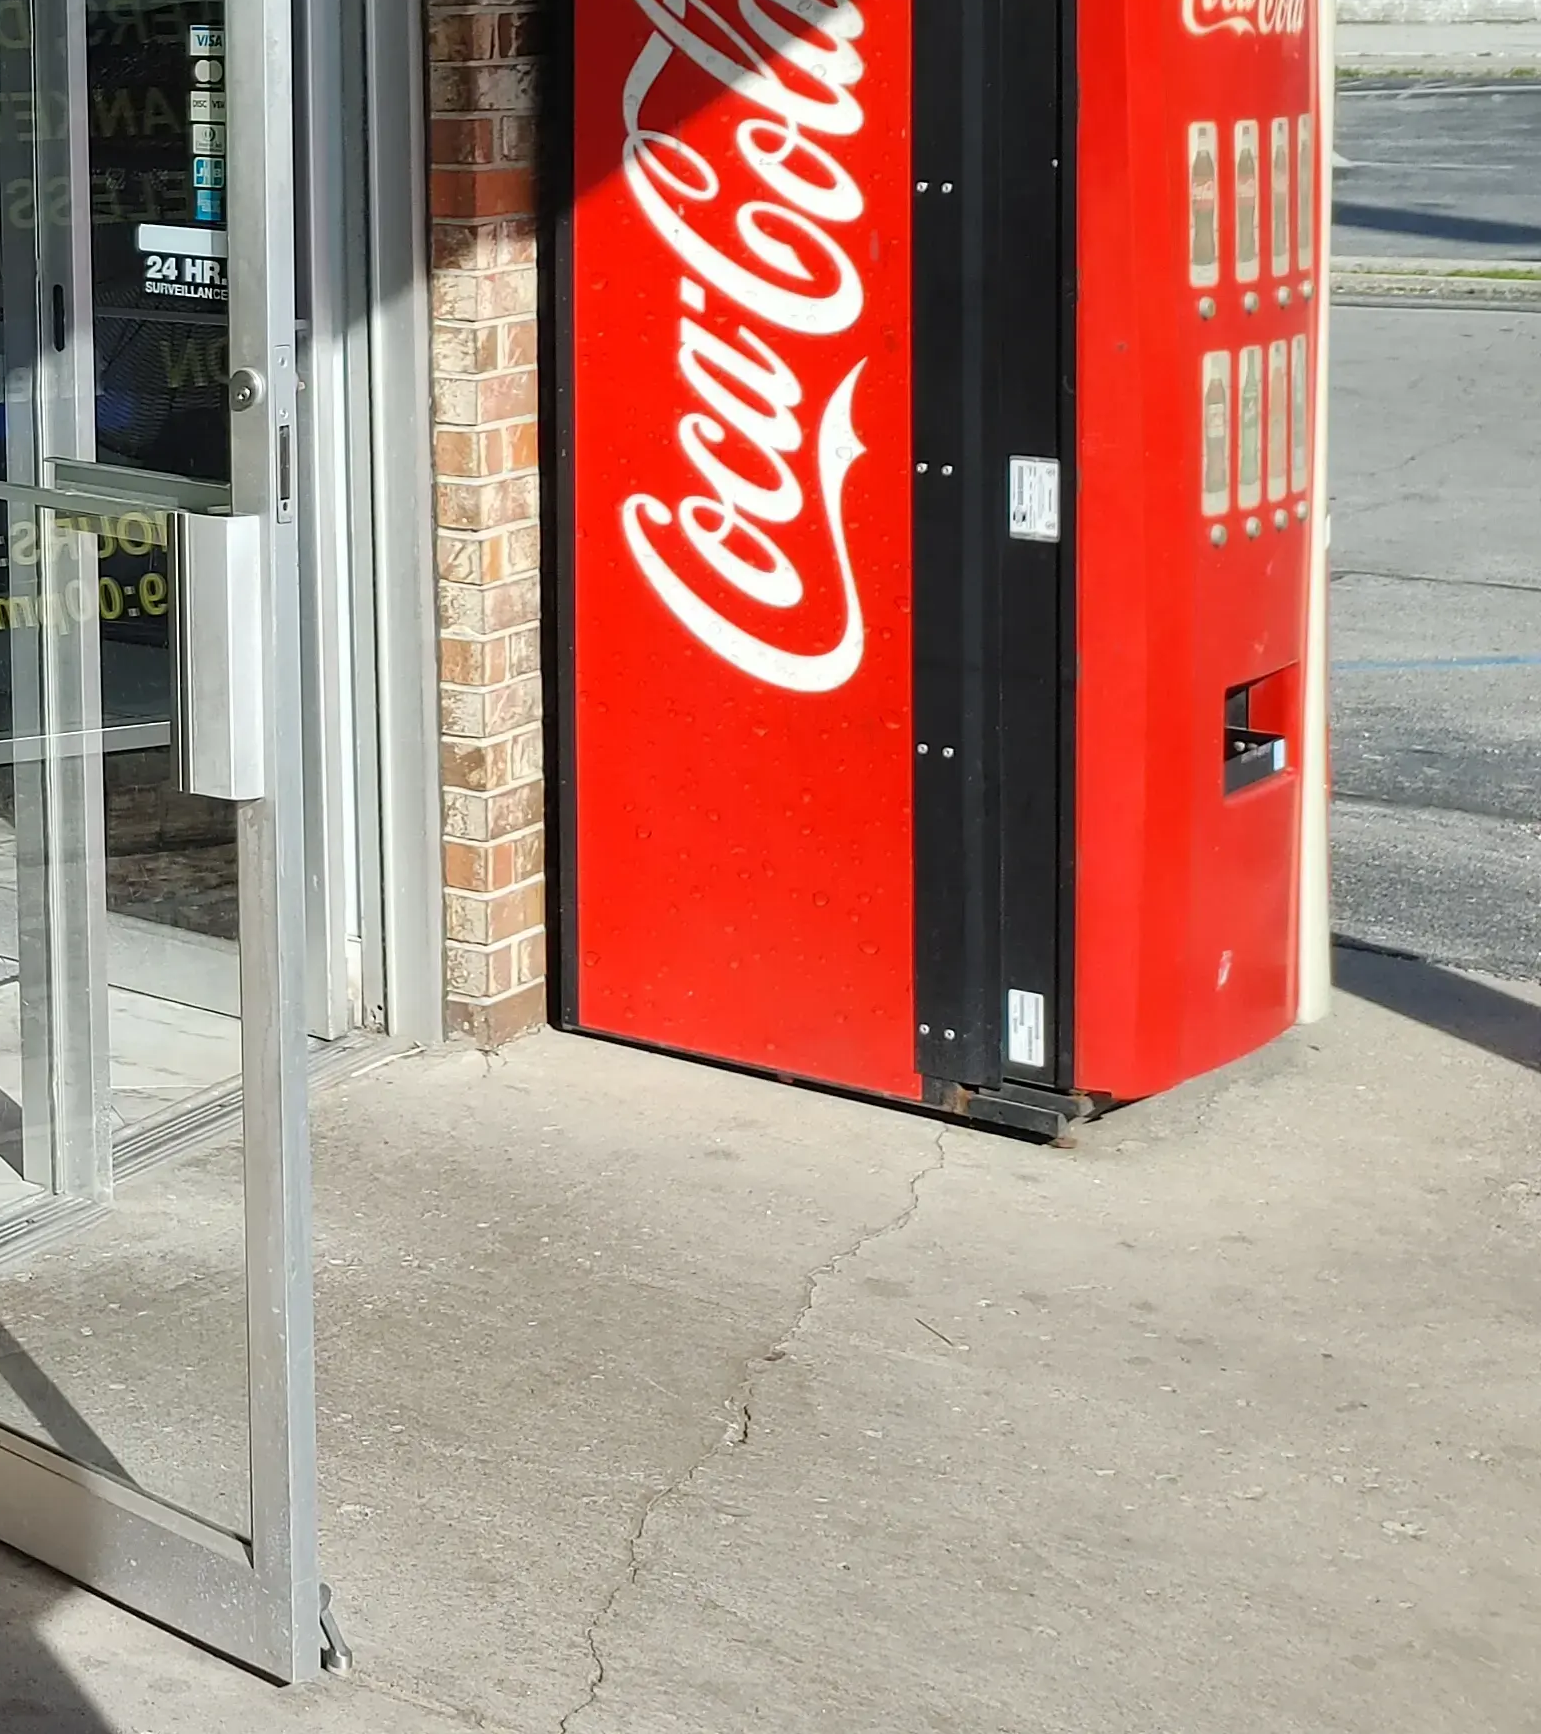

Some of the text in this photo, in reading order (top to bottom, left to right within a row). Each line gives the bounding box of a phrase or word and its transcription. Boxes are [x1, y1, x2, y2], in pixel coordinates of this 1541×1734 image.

[196, 34, 222, 47] VISA
[146, 255, 228, 286] 24 HR.
[144, 280, 229, 301] SURVEILLANCE
